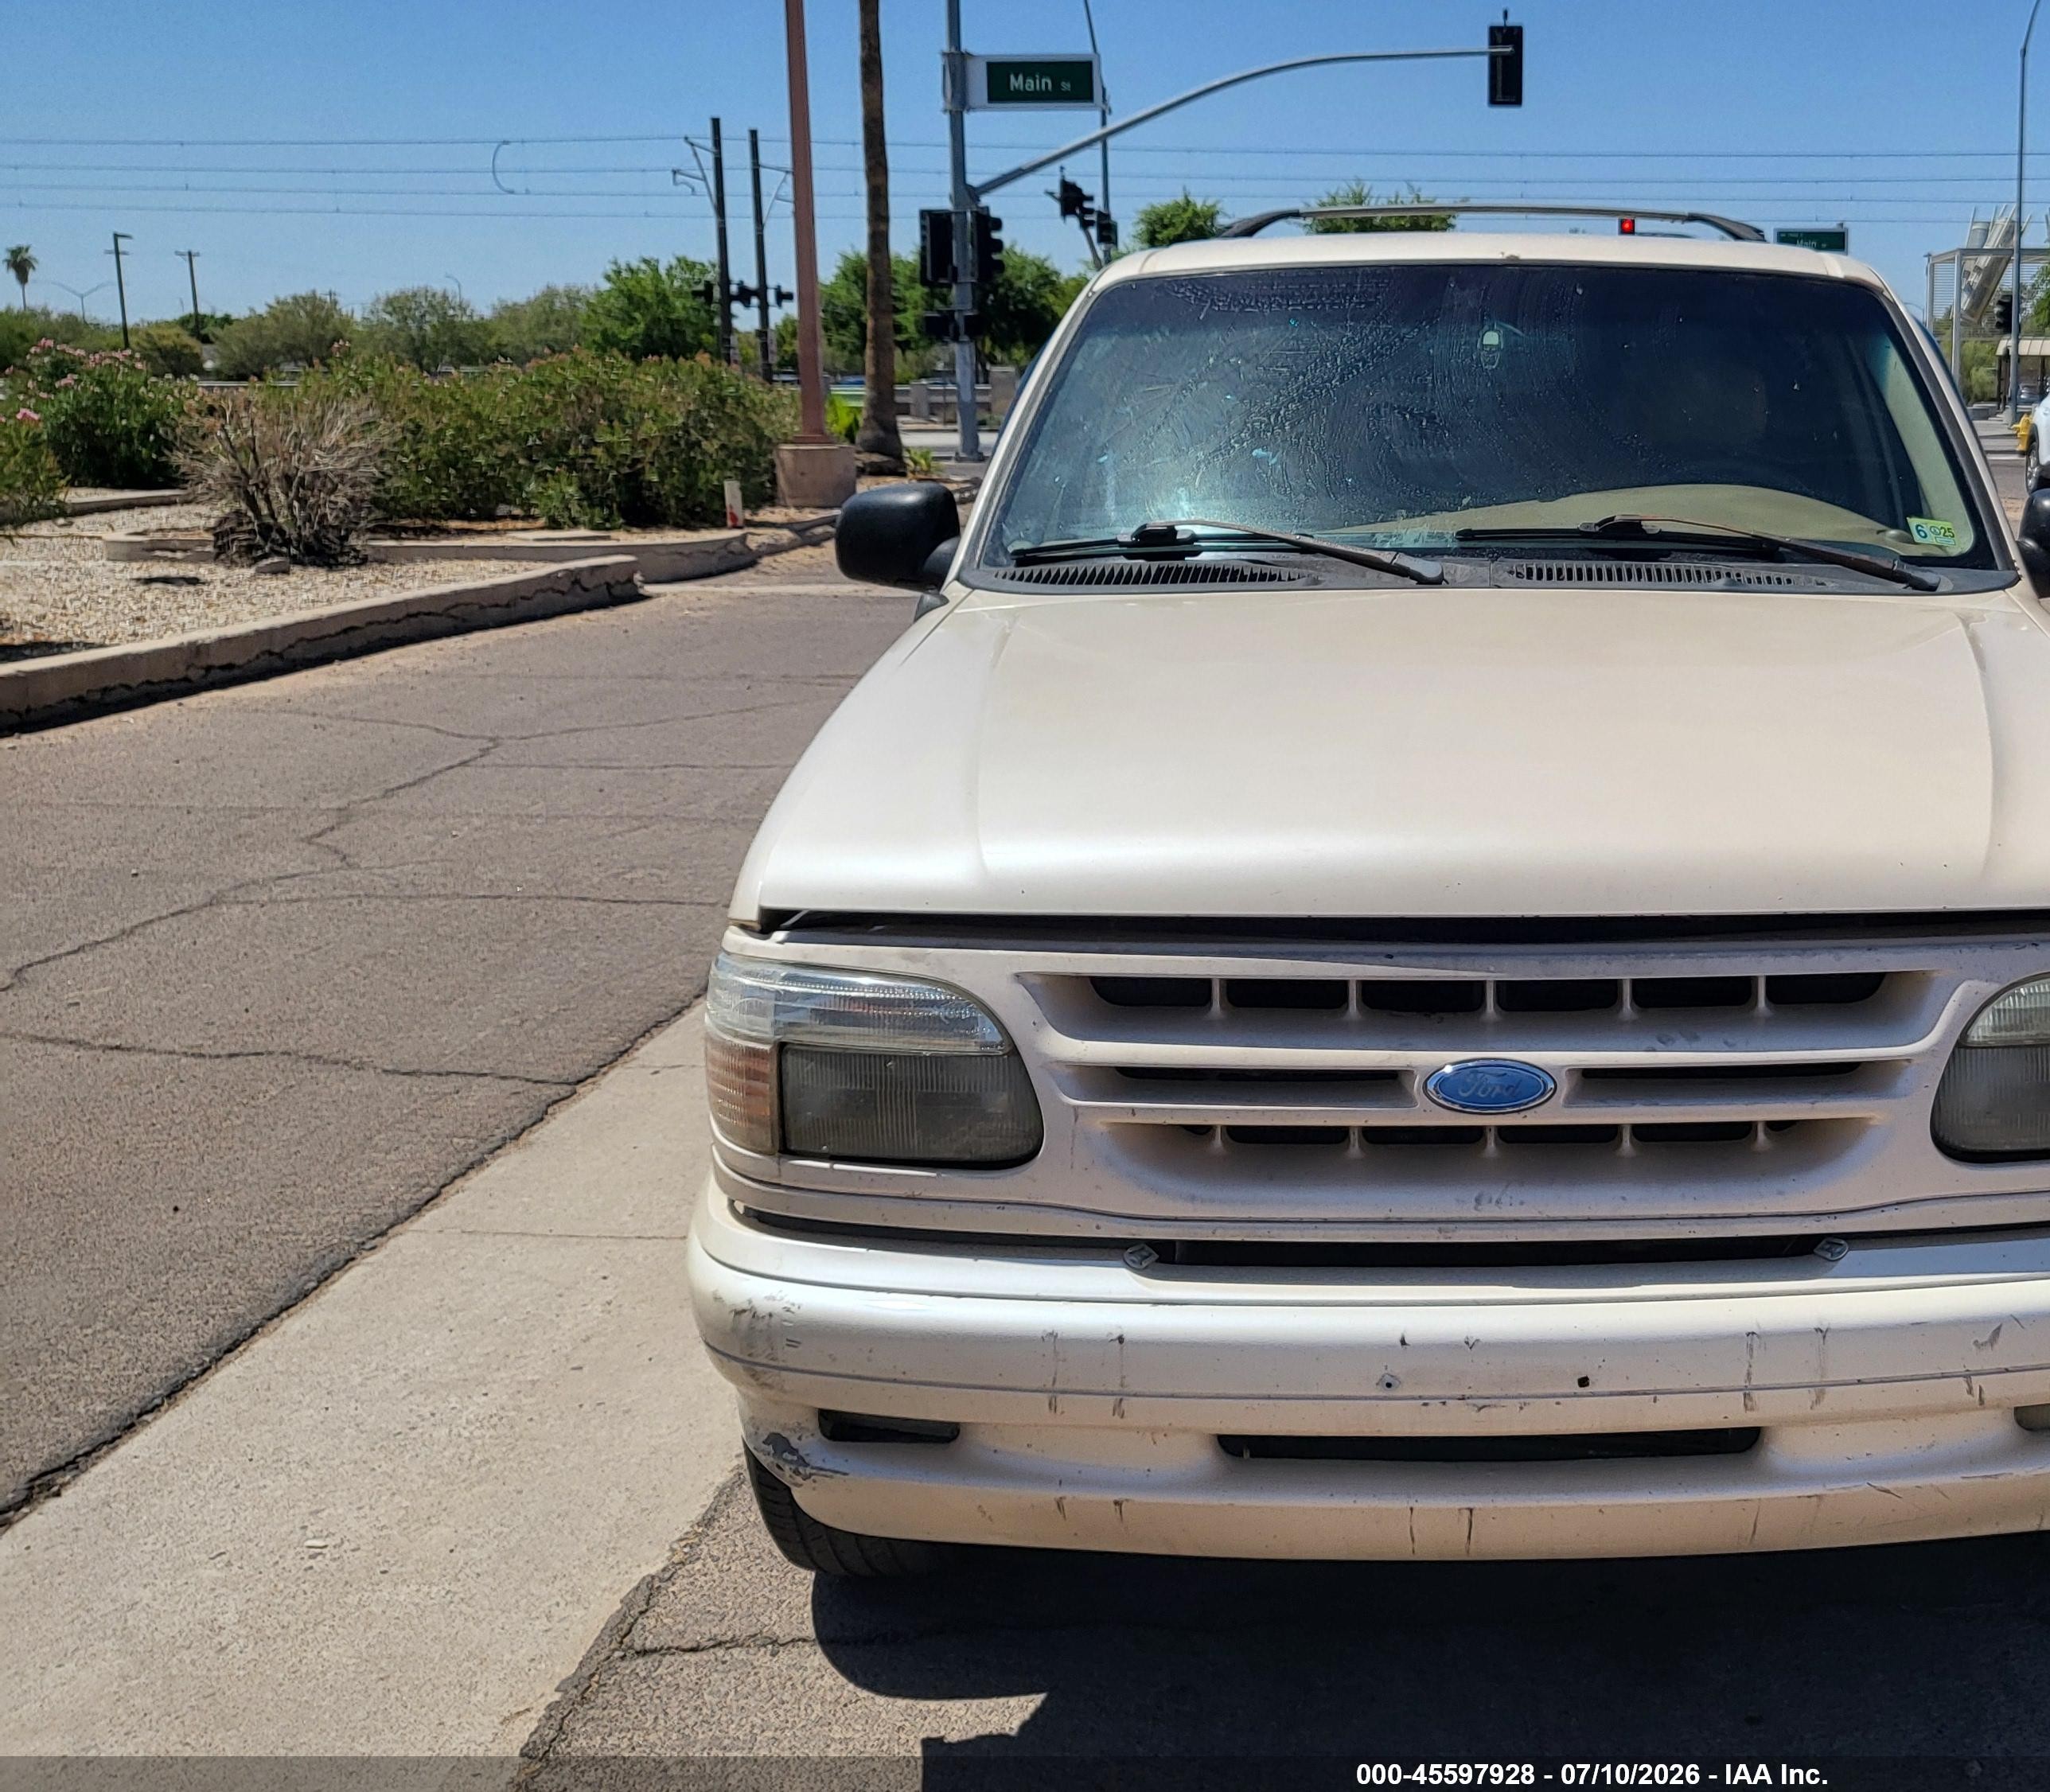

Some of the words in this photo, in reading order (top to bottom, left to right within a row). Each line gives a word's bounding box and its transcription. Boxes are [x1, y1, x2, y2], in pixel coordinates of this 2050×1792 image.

[1009, 73, 1052, 92] Main
[1796, 239, 1817, 250] Main
[1915, 524, 1928, 539] 6
[1940, 526, 1955, 538] 25
[1458, 1069, 1522, 1099] Ford
